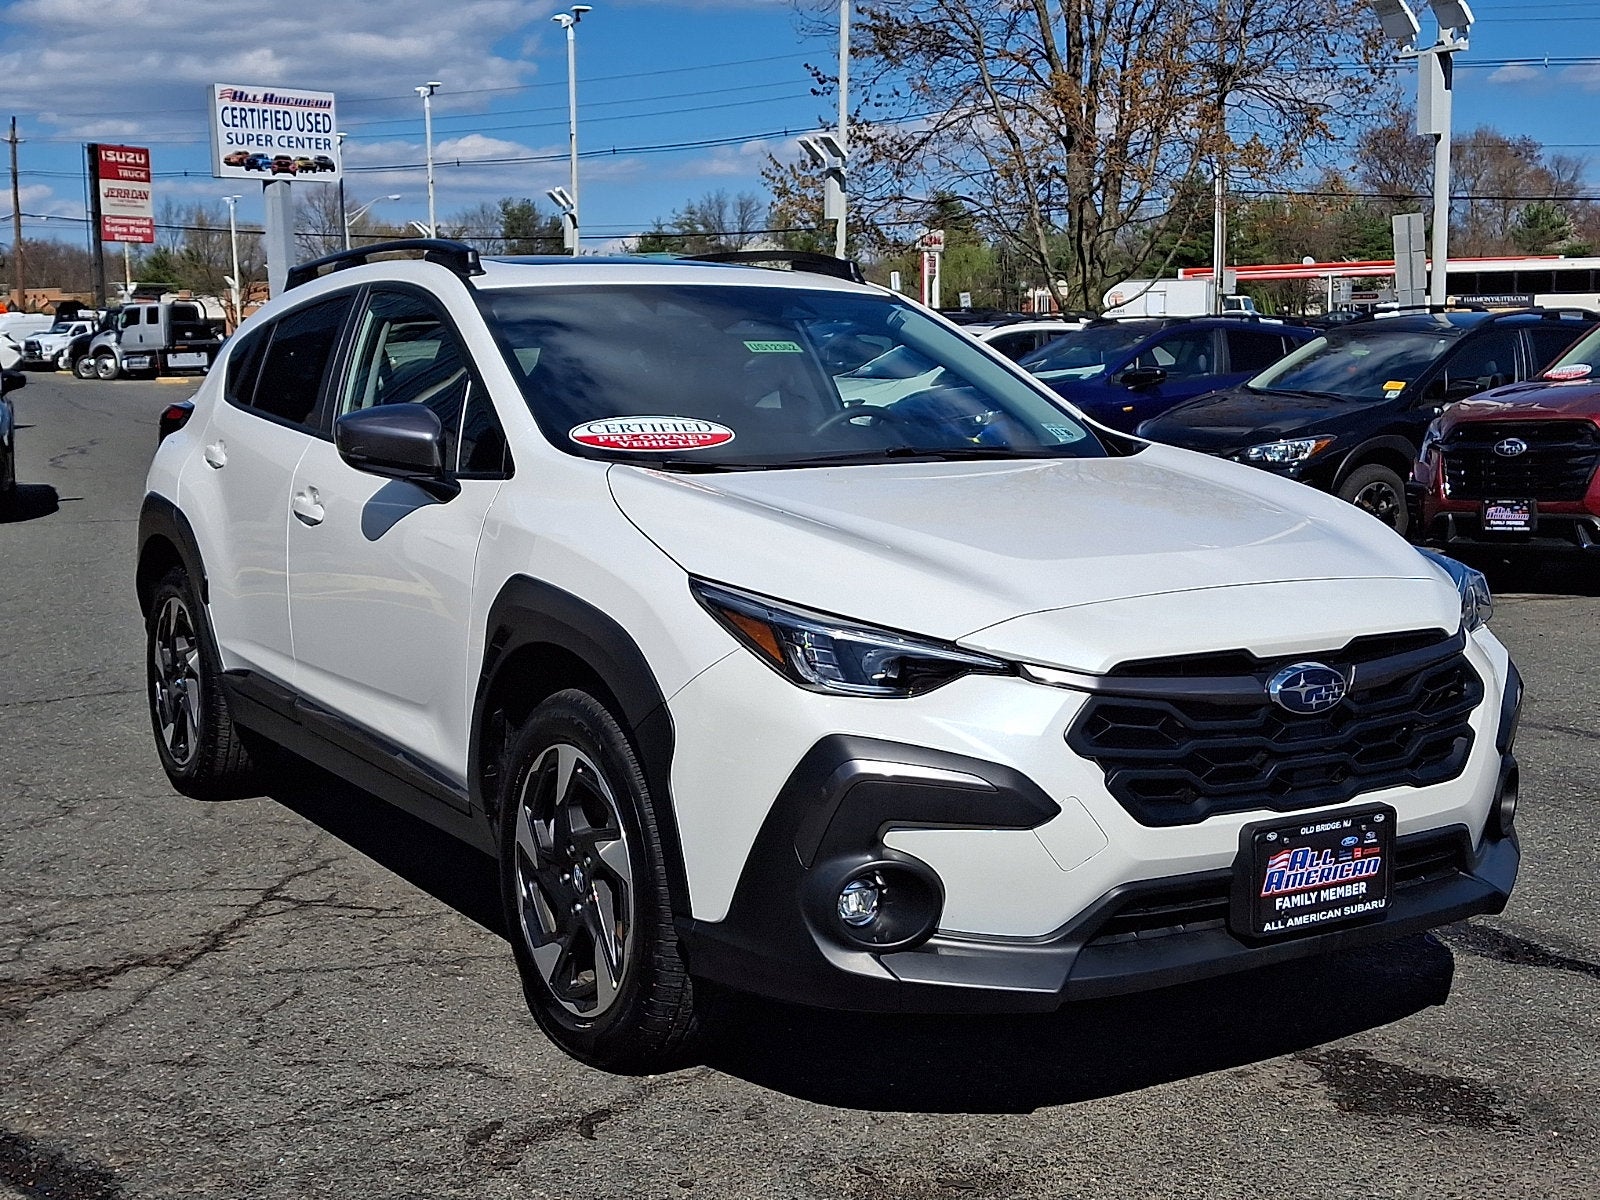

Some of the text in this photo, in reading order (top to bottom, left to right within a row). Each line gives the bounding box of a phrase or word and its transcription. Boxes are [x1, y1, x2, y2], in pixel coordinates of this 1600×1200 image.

[221, 106, 332, 134] CERTIFIED USED
[226, 132, 331, 150] SUPER CENTER
[101, 149, 145, 164] ISUZU
[118, 169, 146, 178] TRUCK
[587, 422, 712, 434] CERTIFIED
[597, 433, 712, 443] PRE-OWNED
[616, 439, 701, 448] VEHICLE
[1300, 825, 1315, 835] OLD
[1342, 818, 1352, 828] NJ
[1287, 847, 1335, 872] ALL
[1262, 857, 1381, 895] AMERICAN
[1275, 882, 1367, 911] FAMILY MEMBER
[1263, 898, 1386, 932] ALL AMERICAN SUBARU
